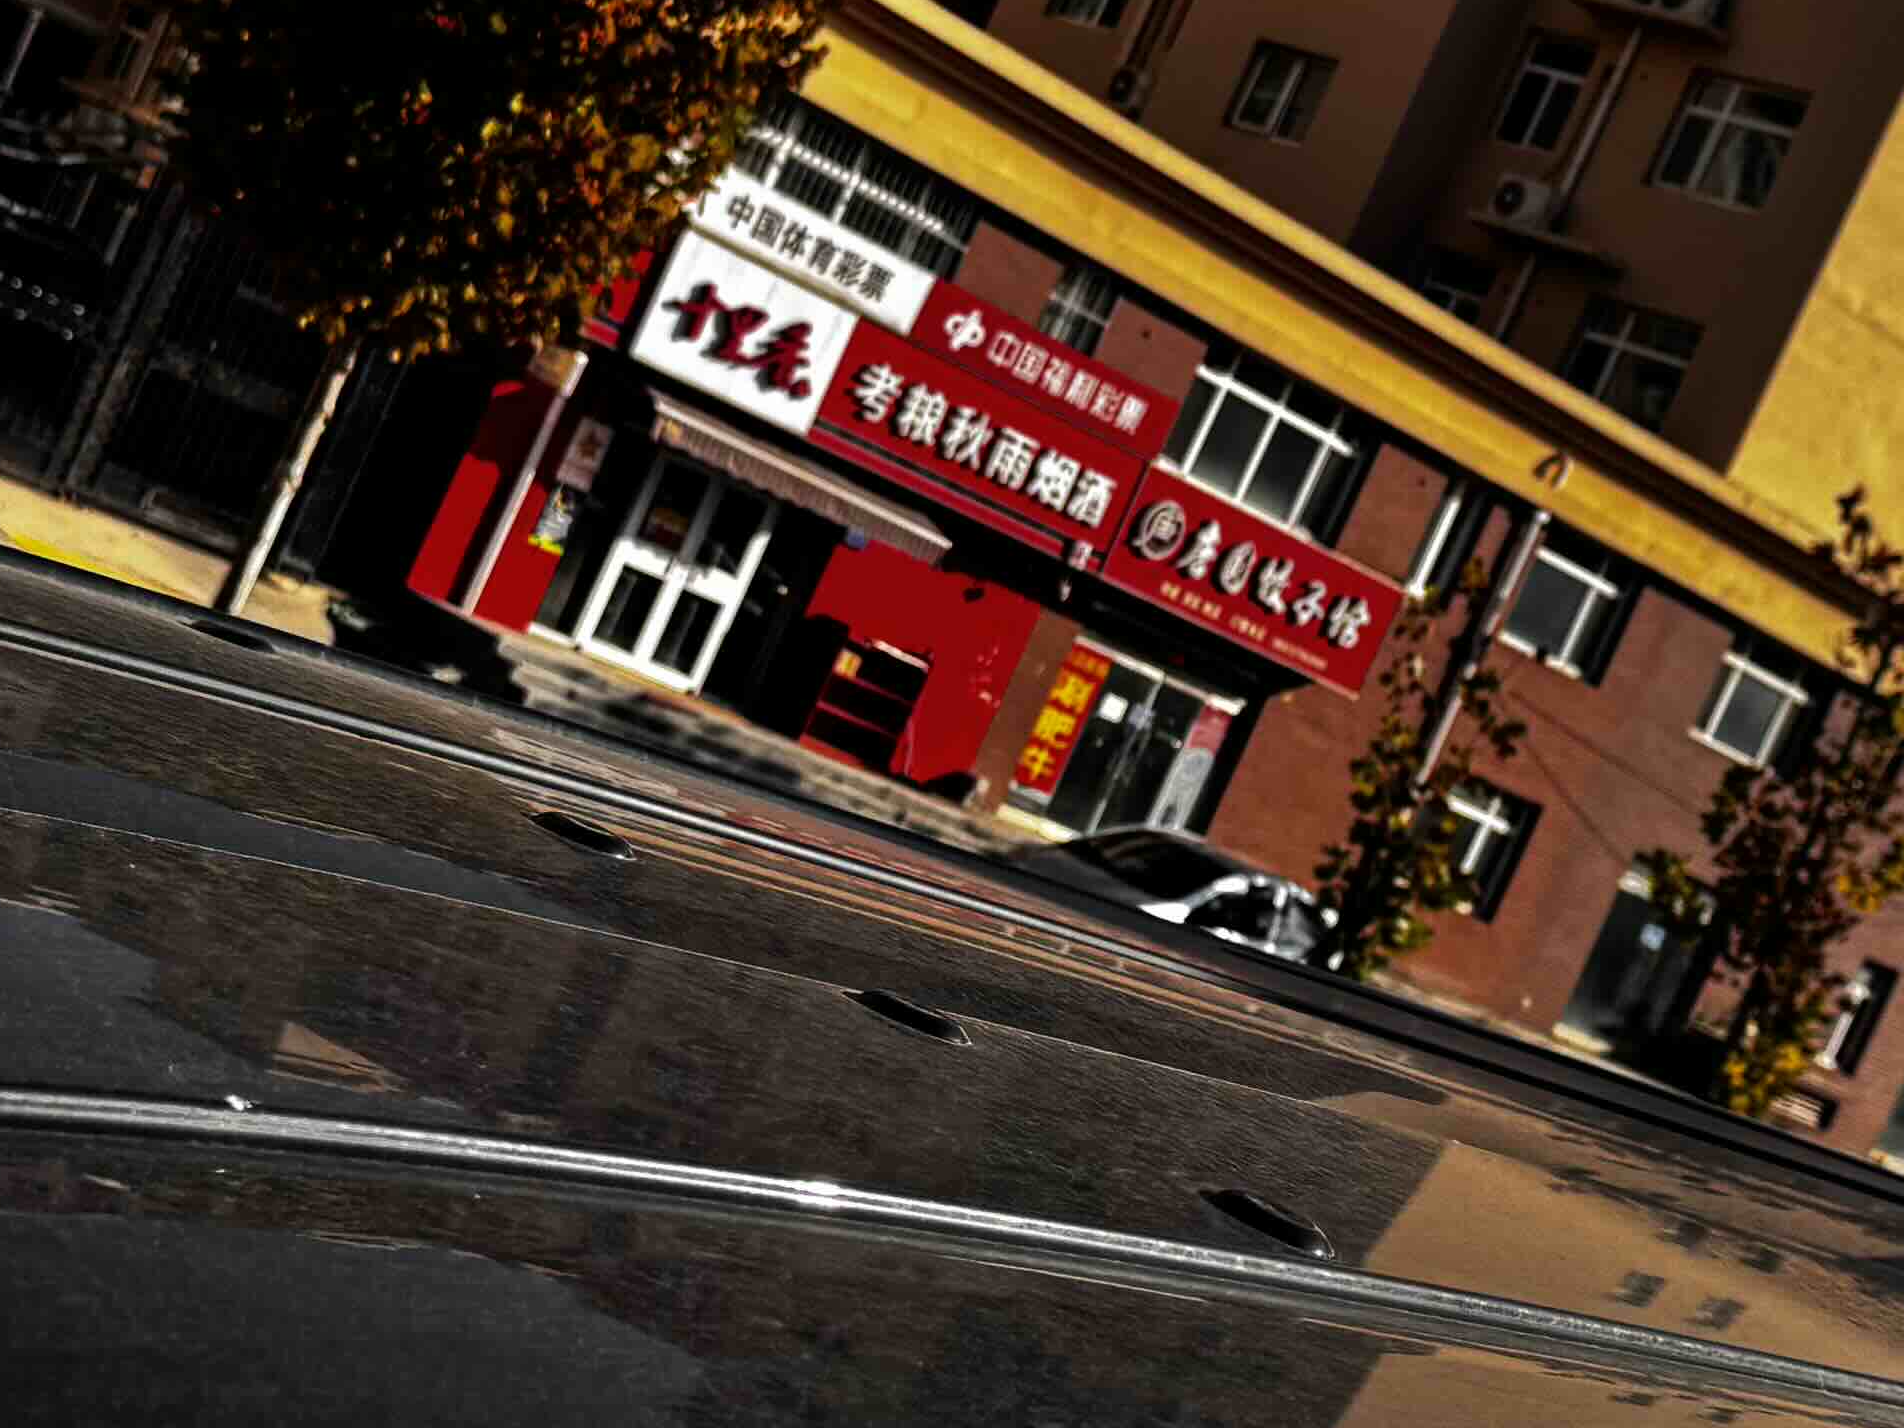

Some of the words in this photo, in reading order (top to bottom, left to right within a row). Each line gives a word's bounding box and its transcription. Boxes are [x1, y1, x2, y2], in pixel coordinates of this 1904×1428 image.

[725, 193, 896, 303] 中国体育彩票
[986, 329, 1150, 436] 中国福利彩票
